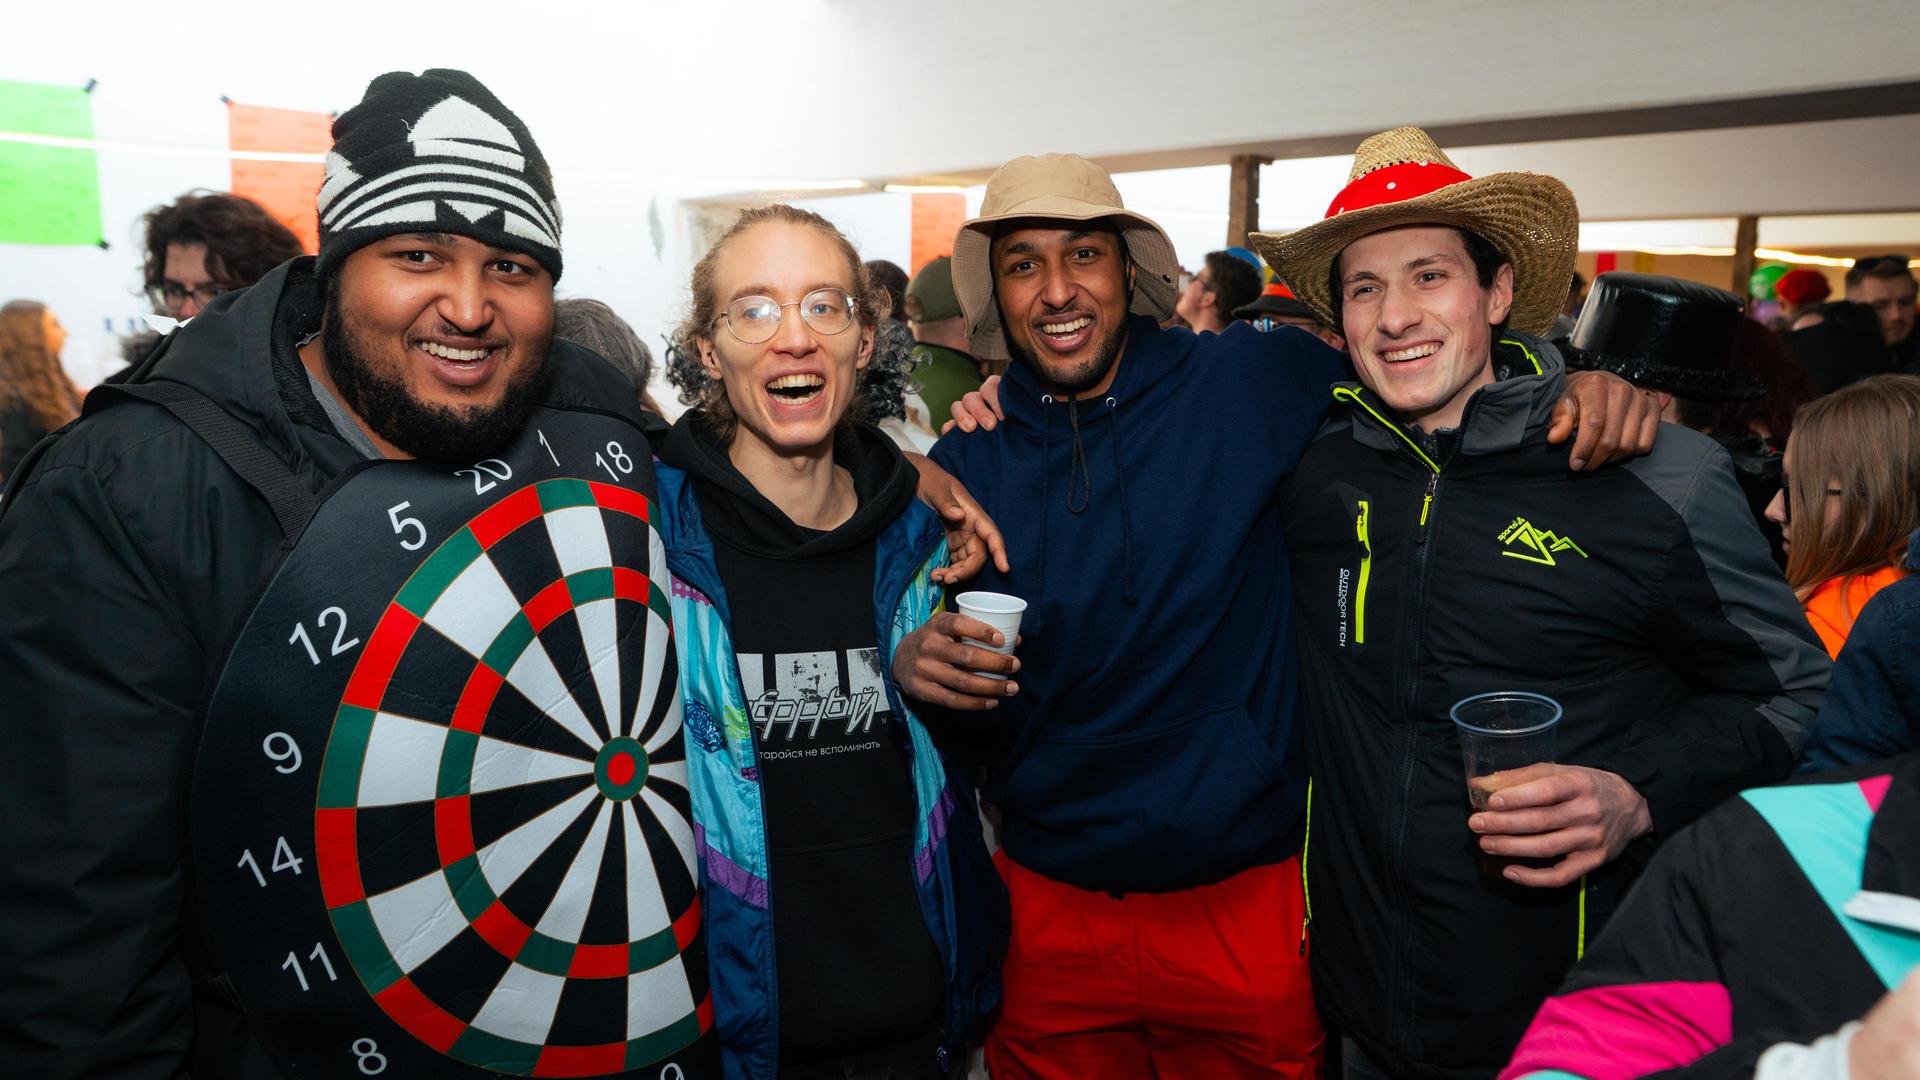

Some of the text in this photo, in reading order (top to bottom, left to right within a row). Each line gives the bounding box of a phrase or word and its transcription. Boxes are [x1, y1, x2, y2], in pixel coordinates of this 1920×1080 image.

[537, 429, 561, 467] 1
[595, 440, 634, 482] 18
[453, 458, 513, 496] 20
[387, 500, 427, 551] 5
[1339, 569, 1350, 647] OUTDOOR TECH
[288, 606, 360, 665] 12
[262, 731, 302, 774] 9
[760, 740, 881, 761] тарайся не вспоминать
[237, 836, 303, 889] 14
[281, 942, 338, 992] 11
[352, 1037, 387, 1075] 8
